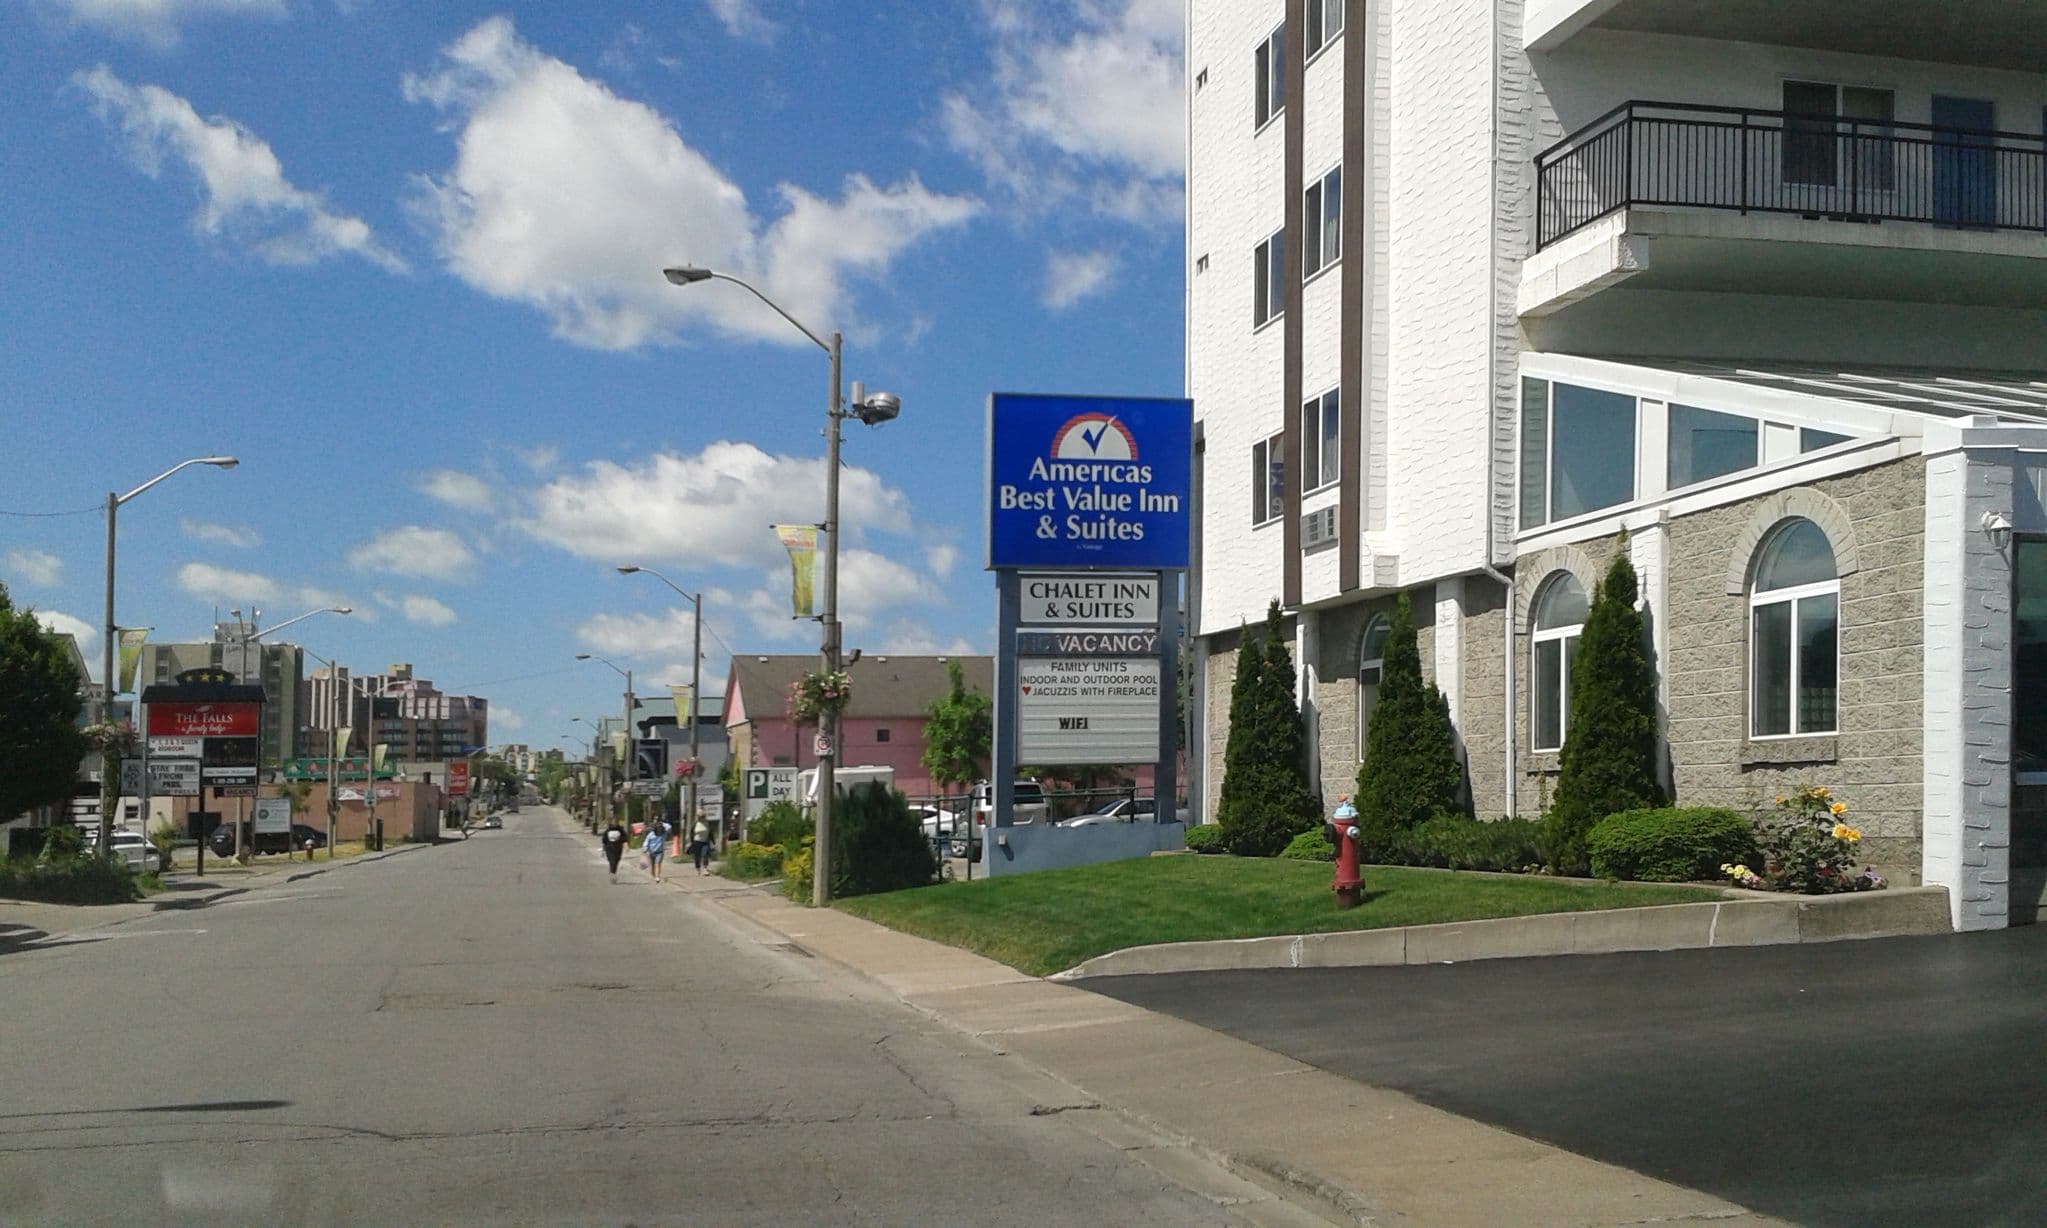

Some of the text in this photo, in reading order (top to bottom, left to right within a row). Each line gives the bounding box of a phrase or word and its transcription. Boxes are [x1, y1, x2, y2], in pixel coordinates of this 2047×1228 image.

[1029, 456, 1152, 484] Americas
[1000, 485, 1179, 513] Best Value Inn
[1036, 514, 1144, 541] & Suites
[1030, 582, 1150, 599] CHALET INN
[1045, 602, 1134, 618] & SUITES
[1057, 635, 1157, 651] VACANCY
[1051, 662, 1127, 672] FAMILY UNITS
[1020, 675, 1158, 685] INDOOR AND OUTDOOR POOL
[1033, 686, 1157, 696] JACUZZIS WITH FIREPLACE
[1059, 717, 1088, 730] WIFI
[773, 773, 791, 783] ALL
[773, 787, 791, 796] DAY
